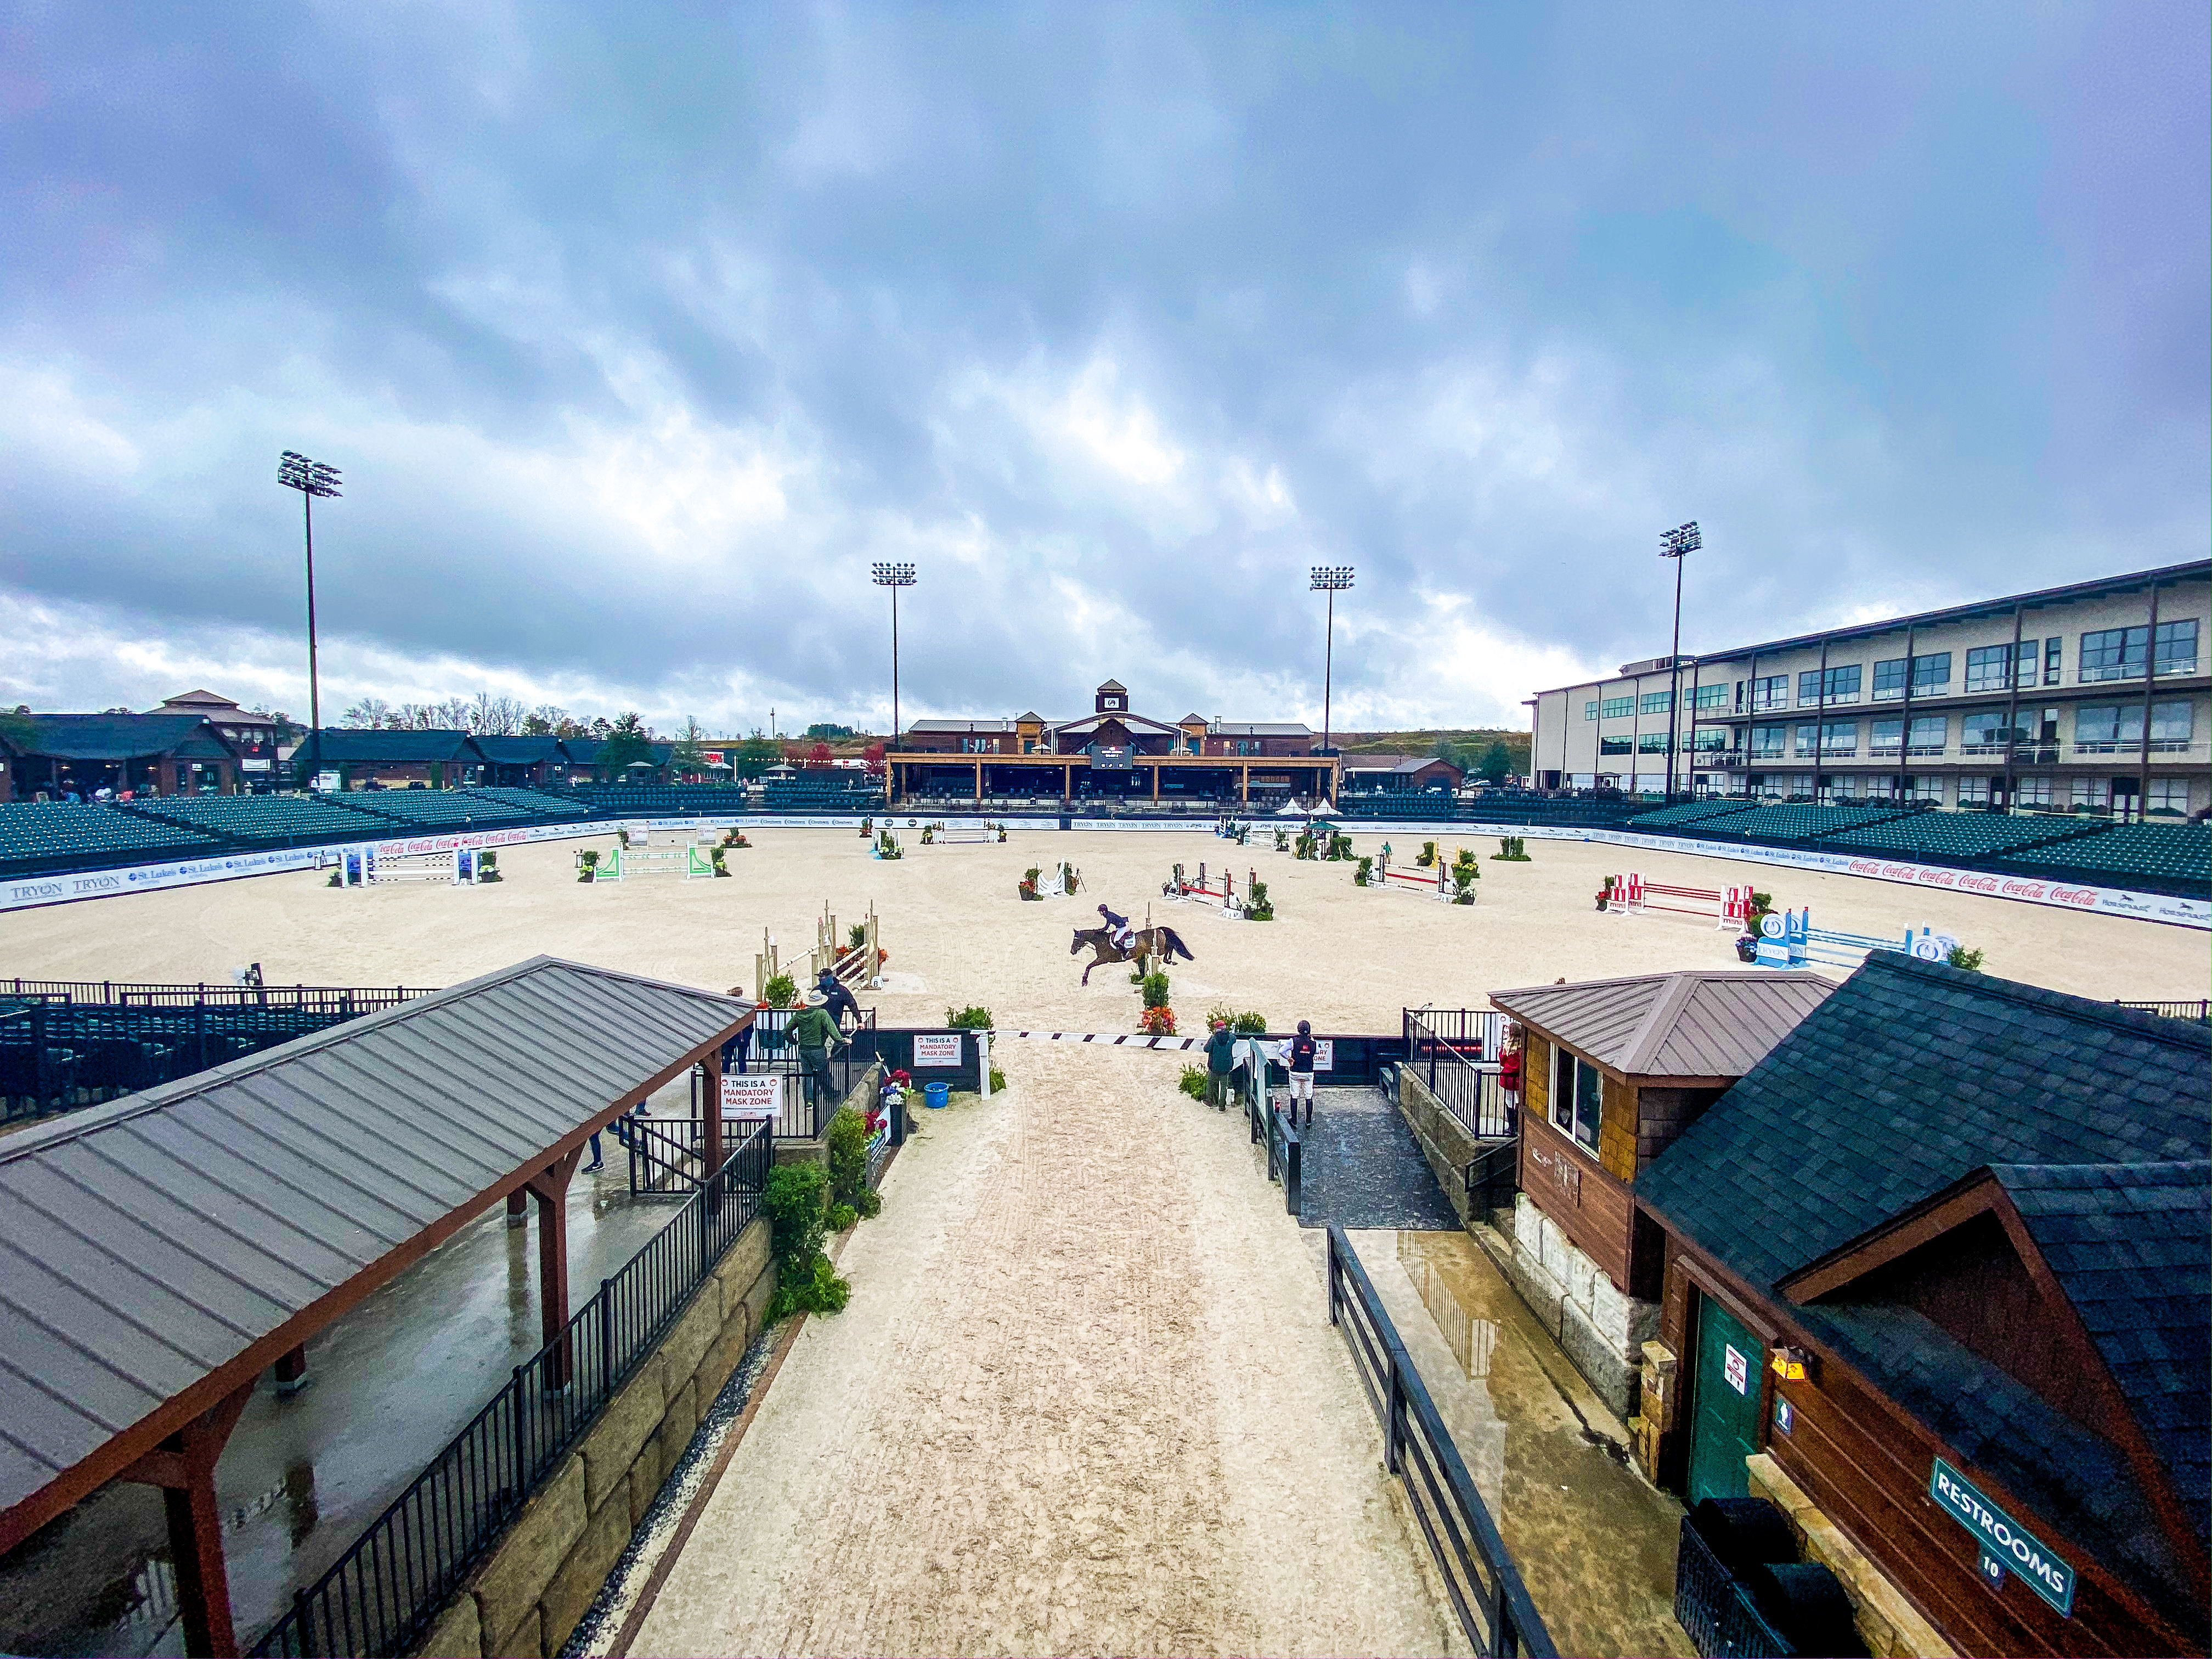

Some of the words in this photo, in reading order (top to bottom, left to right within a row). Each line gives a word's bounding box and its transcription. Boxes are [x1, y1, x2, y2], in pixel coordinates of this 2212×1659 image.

[11, 882, 63, 899] TRYON
[73, 876, 120, 890] TRYON
[1938, 1472, 2064, 1593] RESTROOMS
[1983, 1556, 1999, 1577] 10
